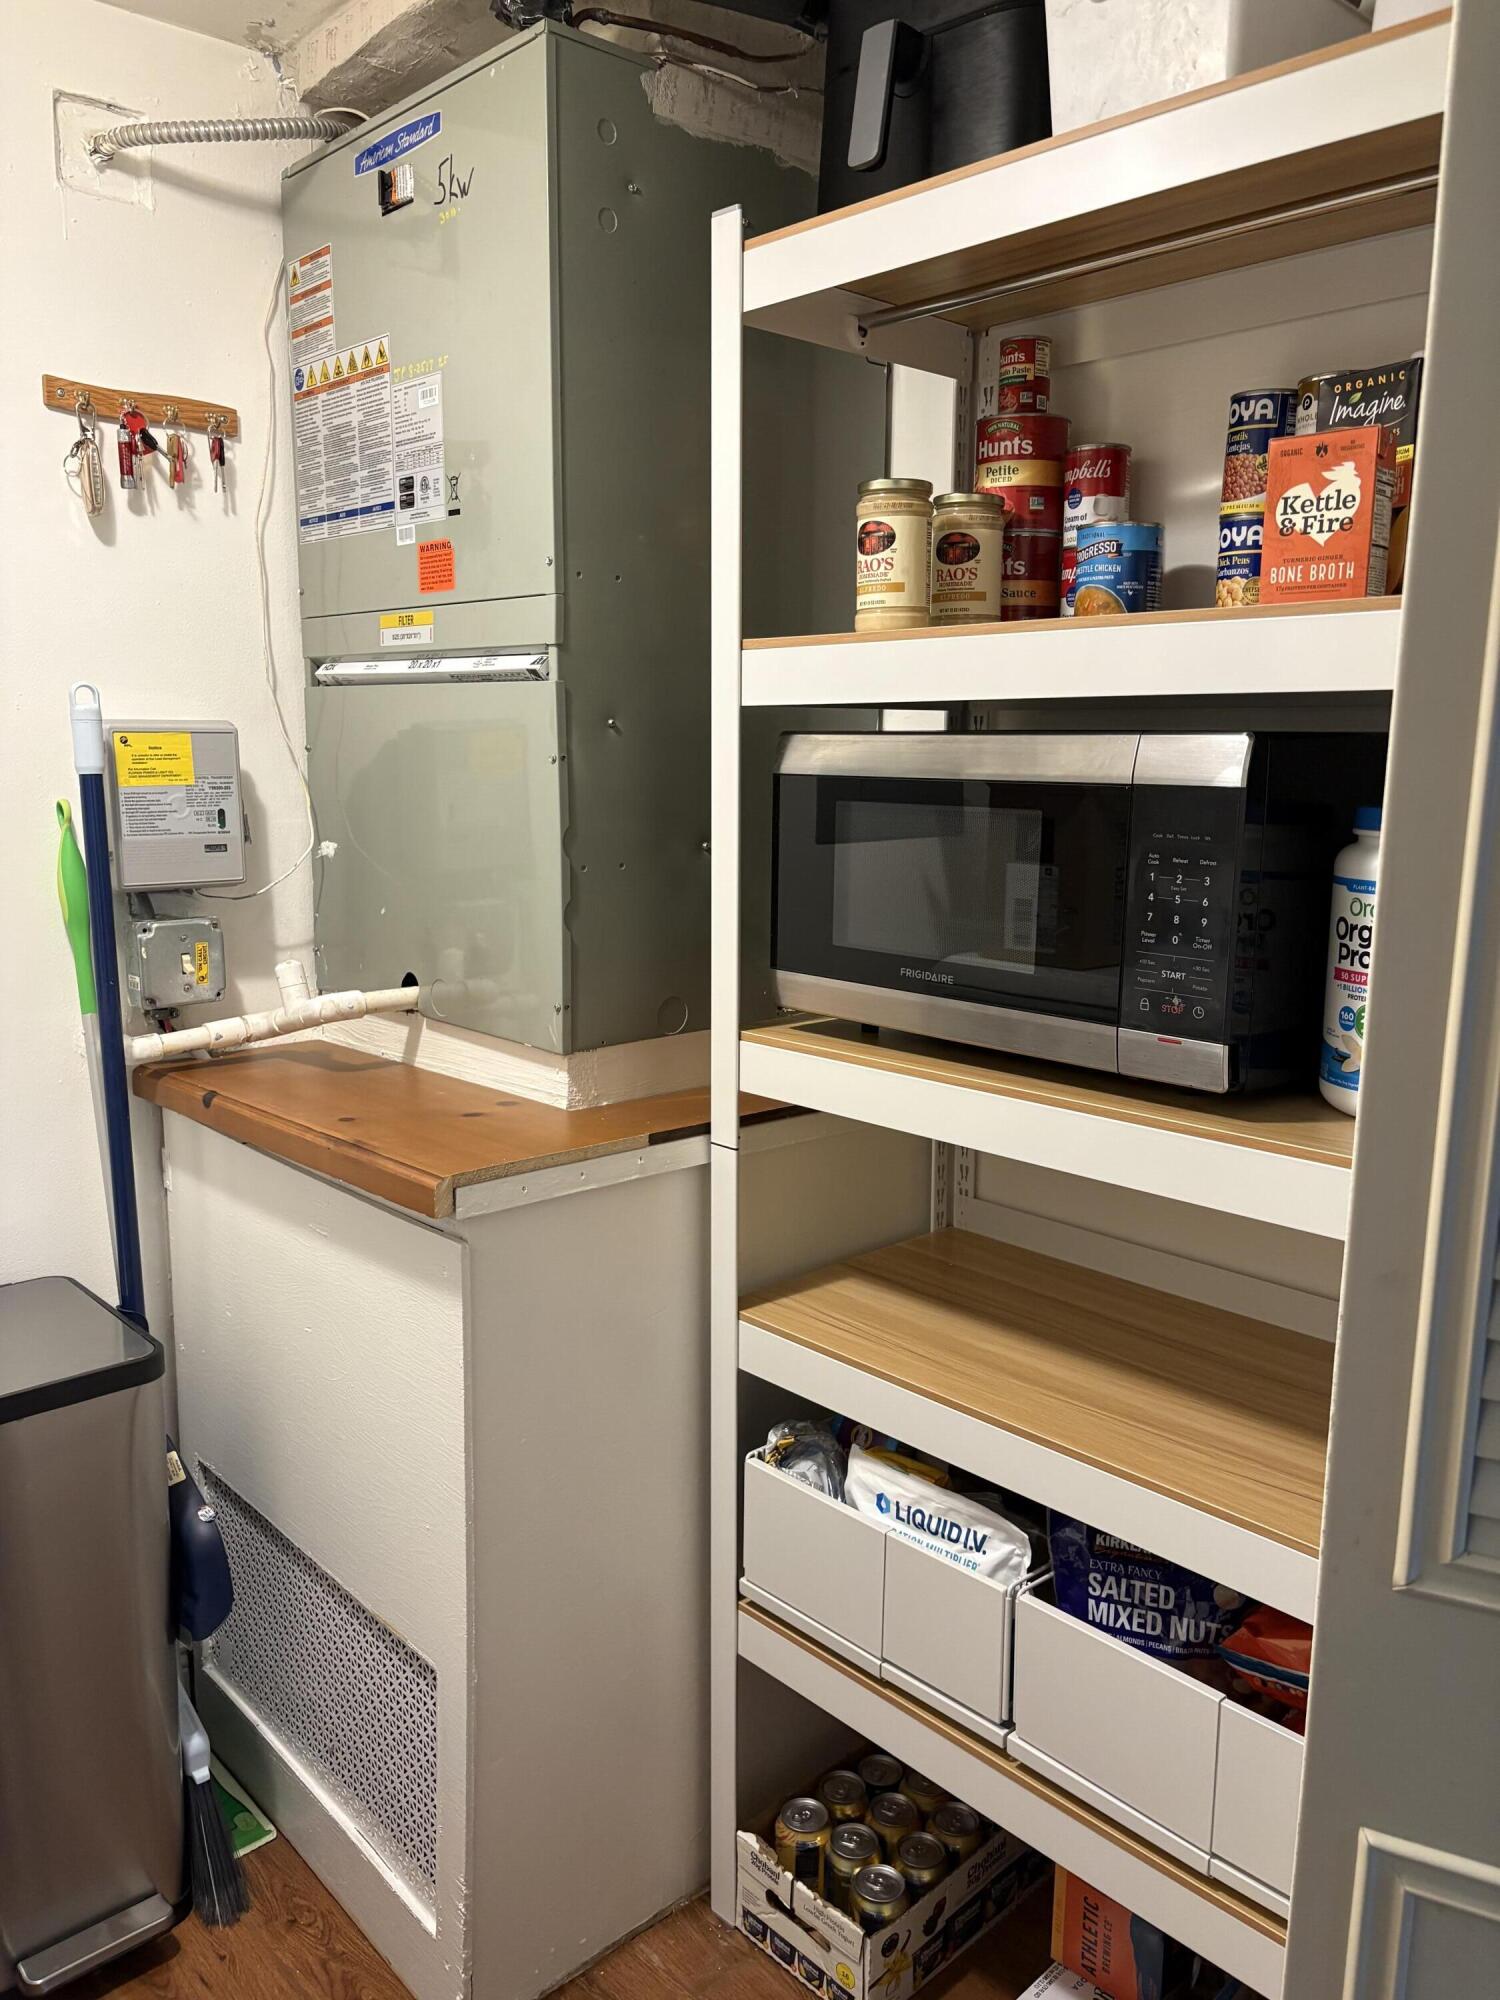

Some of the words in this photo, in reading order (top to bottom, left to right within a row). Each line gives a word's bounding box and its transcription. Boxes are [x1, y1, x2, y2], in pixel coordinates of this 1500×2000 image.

[360, 143, 394, 171] American
[395, 115, 436, 153] Standard
[1335, 370, 1406, 393] ORGANIC
[1230, 398, 1274, 425] OYA
[1329, 390, 1403, 427] Imagine
[997, 421, 1020, 431] NATURAL
[986, 465, 1019, 478] Petite
[1065, 459, 1112, 485] mpbell's
[990, 476, 1013, 484] DICED
[1280, 488, 1356, 516] Kettle
[1279, 518, 1296, 537] &
[1300, 513, 1354, 536] Fire
[1221, 525, 1263, 548] OYA
[419, 541, 452, 553] WARNING
[857, 556, 894, 575] RAO'S
[1232, 556, 1250, 565] Peas
[1094, 564, 1121, 573] CHICKEN
[1270, 565, 1304, 585] BONE
[1309, 561, 1355, 582] BROTH
[936, 567, 978, 583] RAO'S
[1001, 587, 1037, 598] Sauce
[398, 614, 414, 626] FILTER
[1149, 872, 1155, 881] 1
[1176, 874, 1183, 884] 2
[1203, 876, 1210, 886] 3
[1352, 884, 1375, 892] PLANT-BA
[1147, 892, 1154, 902] 4
[1175, 894, 1181, 904] 5
[1202, 897, 1209, 907] 6
[1349, 897, 1374, 918] Or
[1146, 912, 1153, 921] 7
[1173, 915, 1180, 924] 8
[1201, 917, 1208, 927] 9
[1336, 916, 1373, 949] Org
[1172, 935, 1179, 945] 0
[1338, 942, 1371, 970] Pro
[900, 967, 954, 985] FRIGIDAIRE
[1161, 970, 1187, 981] START
[1341, 972, 1349, 980] 50
[1350, 973, 1368, 982] SUP
[1347, 993, 1367, 1002] PROTEI
[1161, 1003, 1184, 1014] STOP
[1341, 1011, 1354, 1021] 160
[896, 1500, 962, 1544] LIQUID
[963, 1528, 987, 1555] I.V.
[1089, 1558, 1125, 1575] EXTRA
[1128, 1564, 1163, 1581] FANCY
[1088, 1572, 1176, 1610] SALTED
[1088, 1598, 1163, 1636] MIXED
[1149, 1641, 1172, 1653] PECANS
[750, 1850, 781, 1880] Chobani
[1081, 1895, 1100, 1978] ATHLETIC
[1102, 1932, 1114, 1976] BREWING
